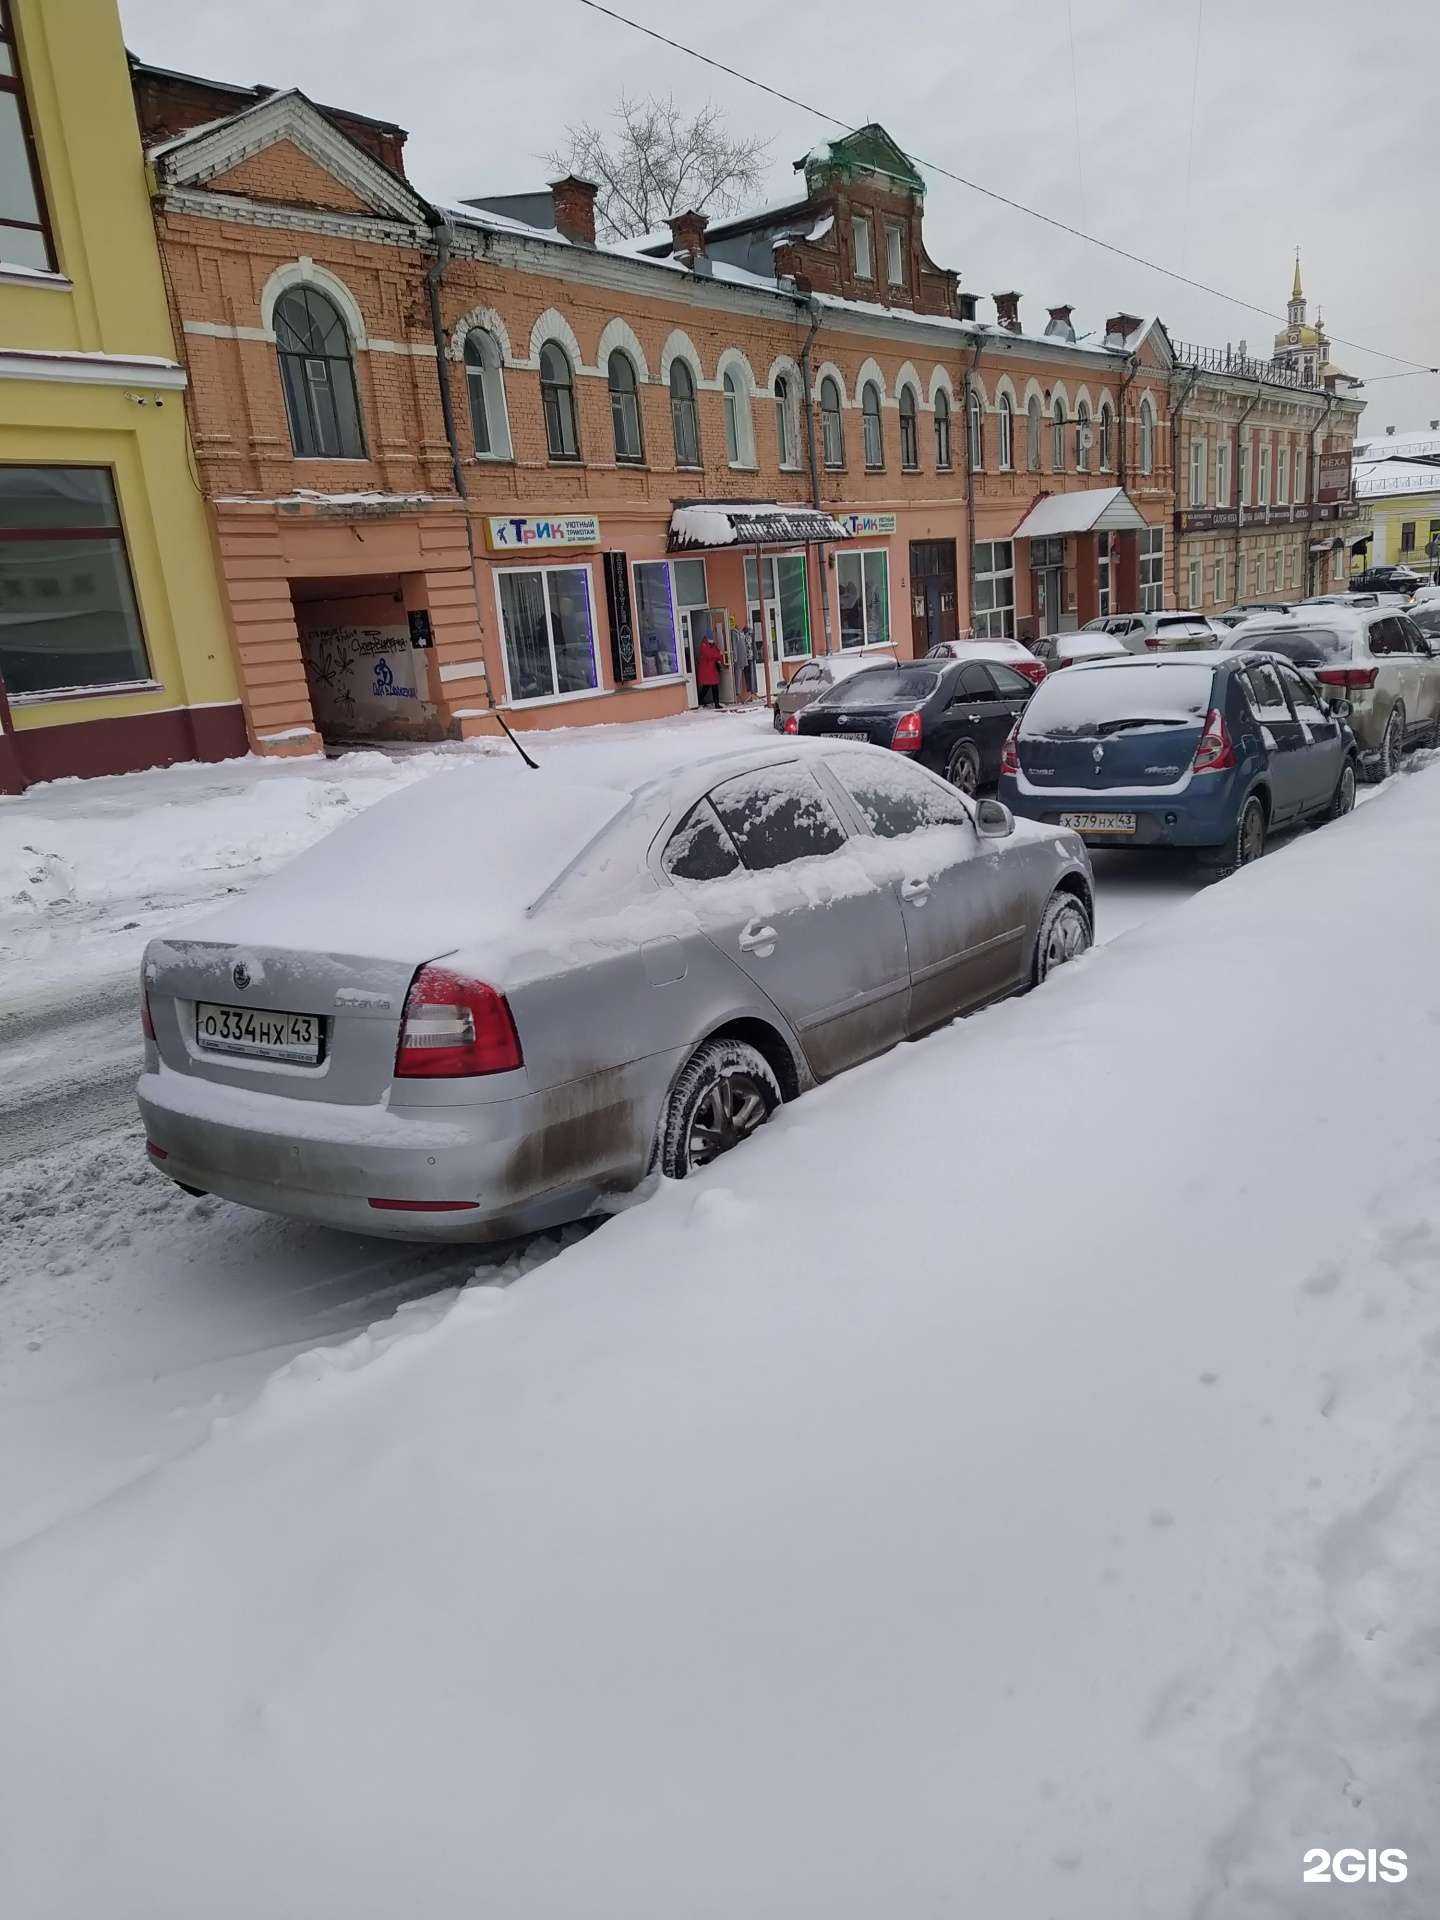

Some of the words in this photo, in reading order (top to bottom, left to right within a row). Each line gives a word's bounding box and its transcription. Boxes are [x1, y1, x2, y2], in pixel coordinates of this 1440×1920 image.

[1320, 457, 1346, 468] МЕХА
[565, 519, 595, 529] УЮТНЫЙ
[291, 1018, 312, 1042] 43
